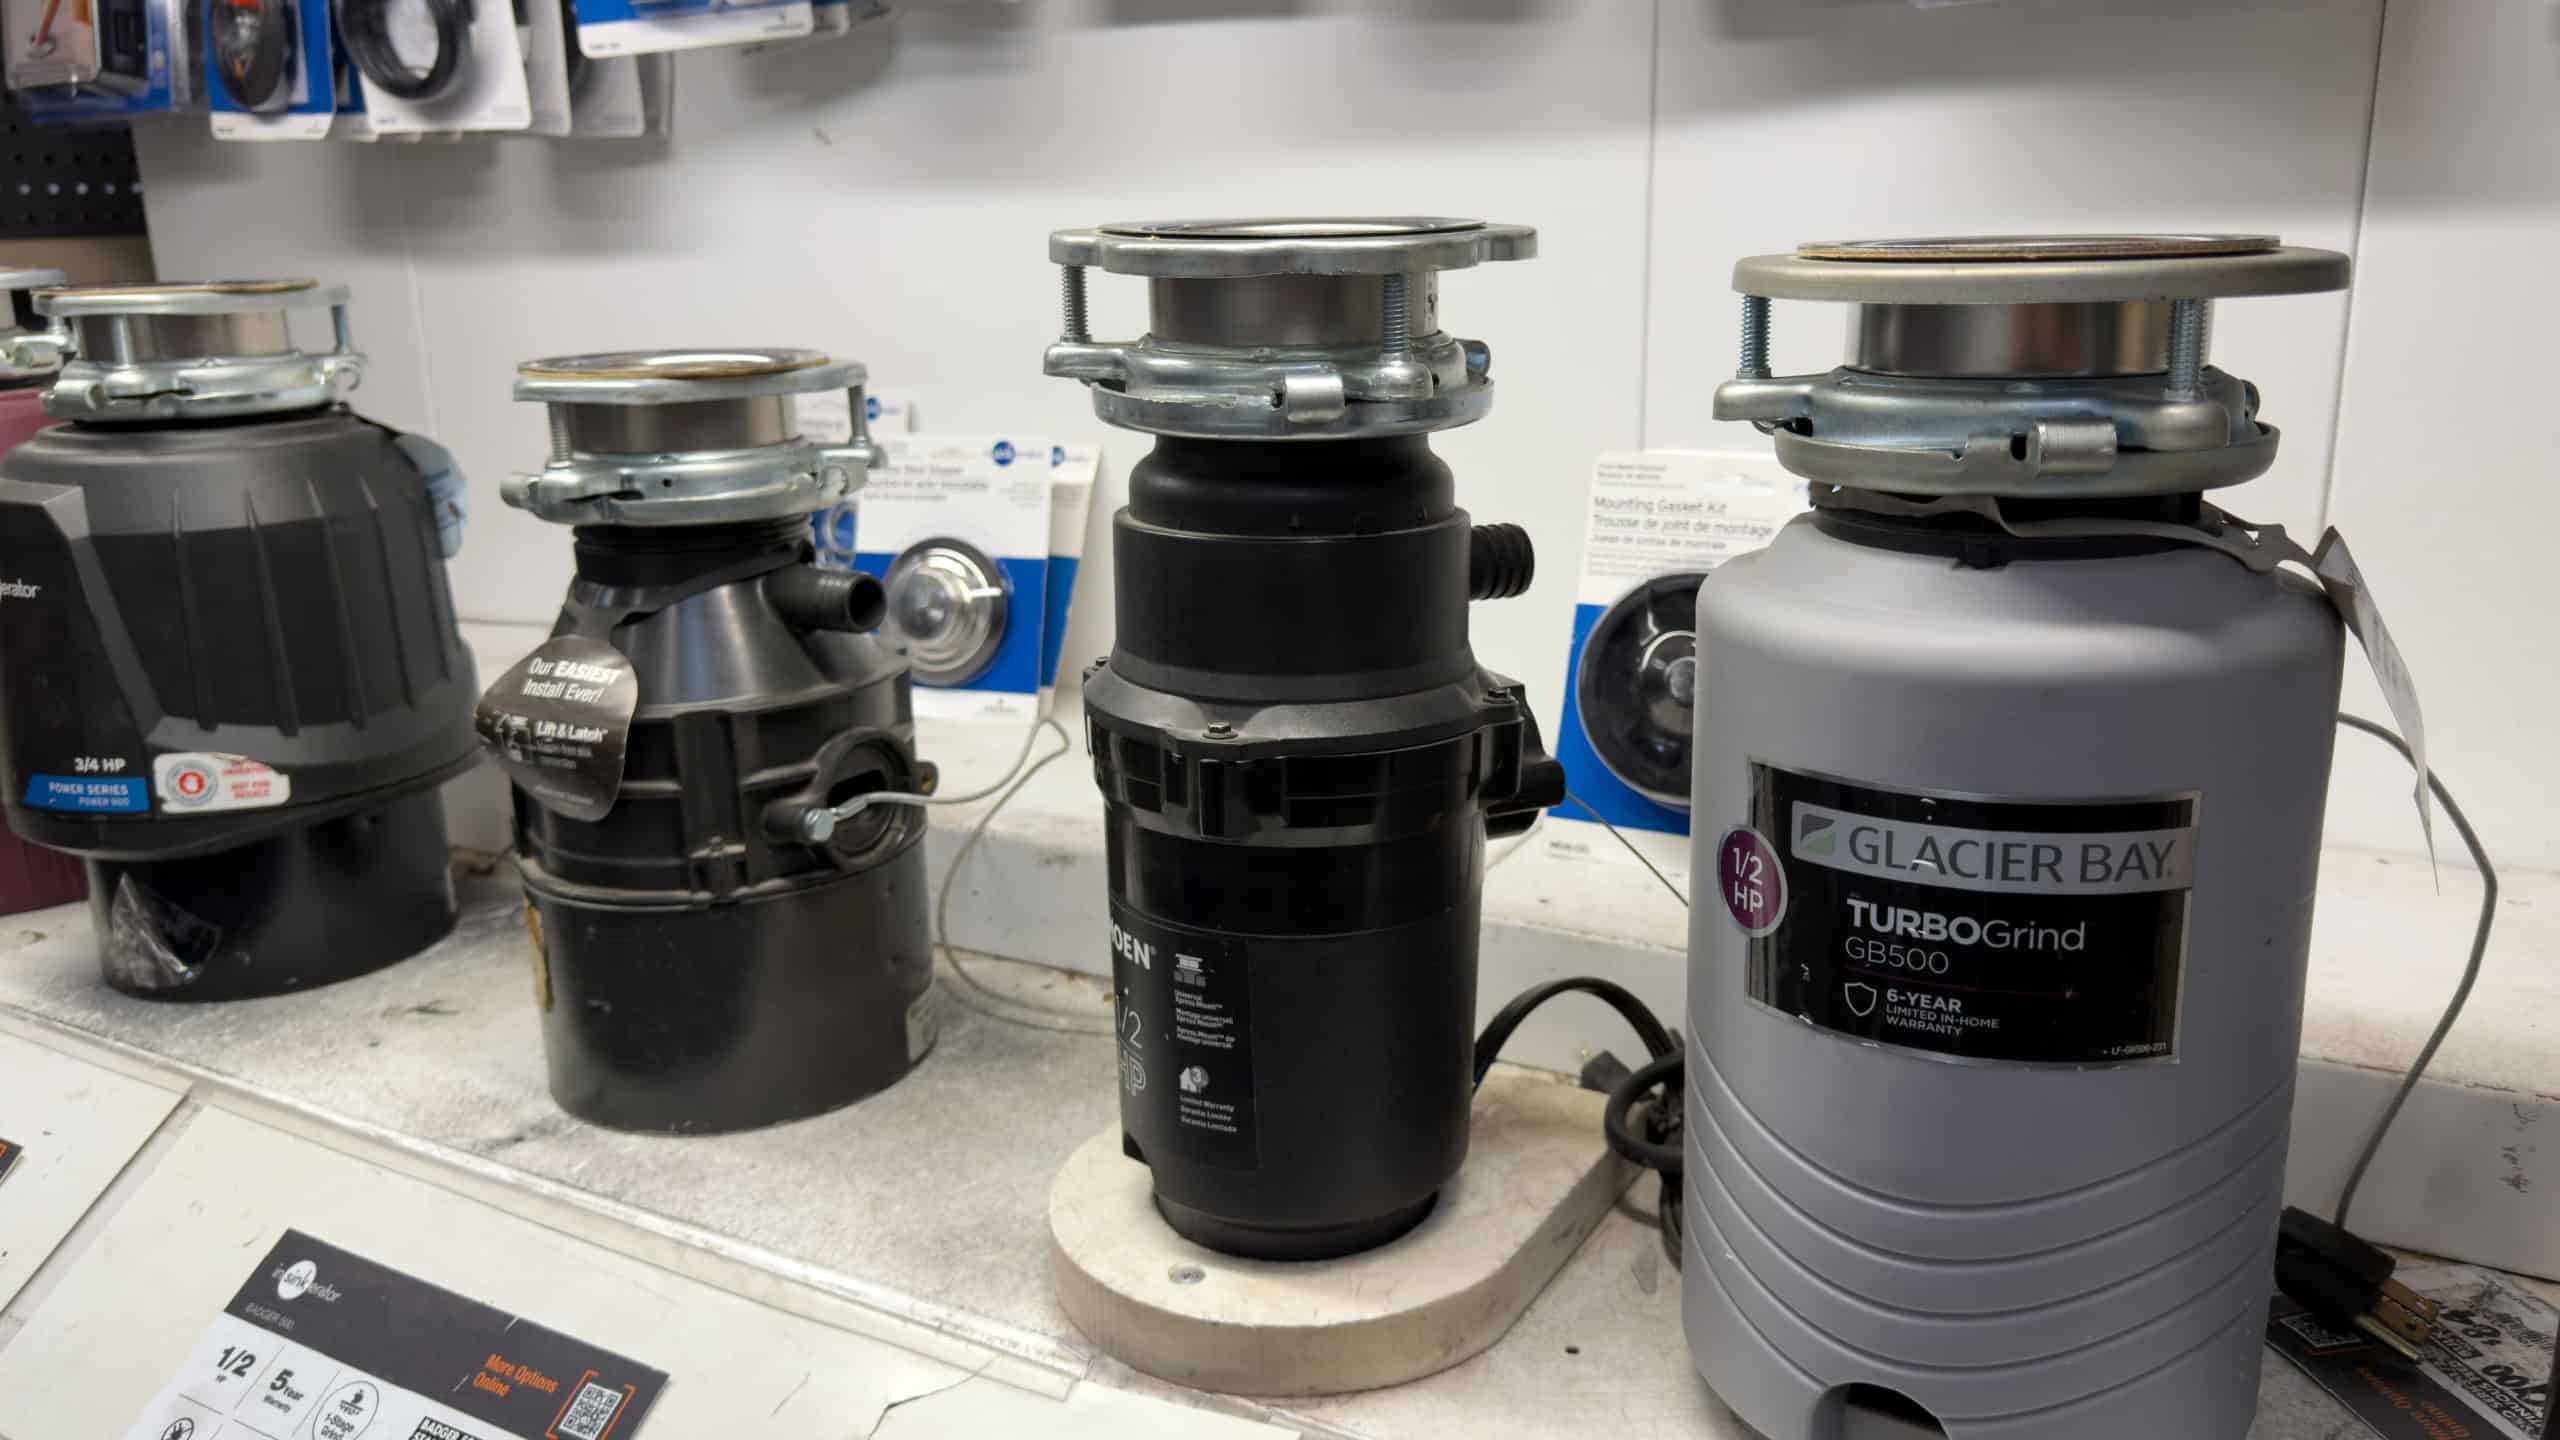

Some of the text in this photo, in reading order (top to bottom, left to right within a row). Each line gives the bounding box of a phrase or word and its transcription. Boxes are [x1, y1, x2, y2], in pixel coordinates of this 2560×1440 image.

[0, 577, 42, 600] erator
[529, 657, 622, 686] Our EASIEST
[522, 679, 605, 704] Install Ever!
[535, 721, 557, 738] Lift
[557, 723, 568, 739] &
[74, 757, 126, 773] 3/4 HP
[49, 782, 129, 796] POWER SERIES
[1733, 847, 1763, 885] 1/2
[1849, 826, 2063, 883] GLACIER
[1733, 886, 1764, 912] HP
[1847, 898, 2085, 951] TURBOGrind
[1845, 936, 1949, 974] GB500
[1886, 988, 1962, 1013] 6-YEAR
[1886, 1005, 2001, 1029] LIMITED IN-HOME
[1886, 1014, 1963, 1036] WARRANTY
[217, 1346, 257, 1378] 1/2
[485, 1353, 560, 1393] More Options
[270, 1367, 295, 1391] 5
[472, 1371, 511, 1398] Online
